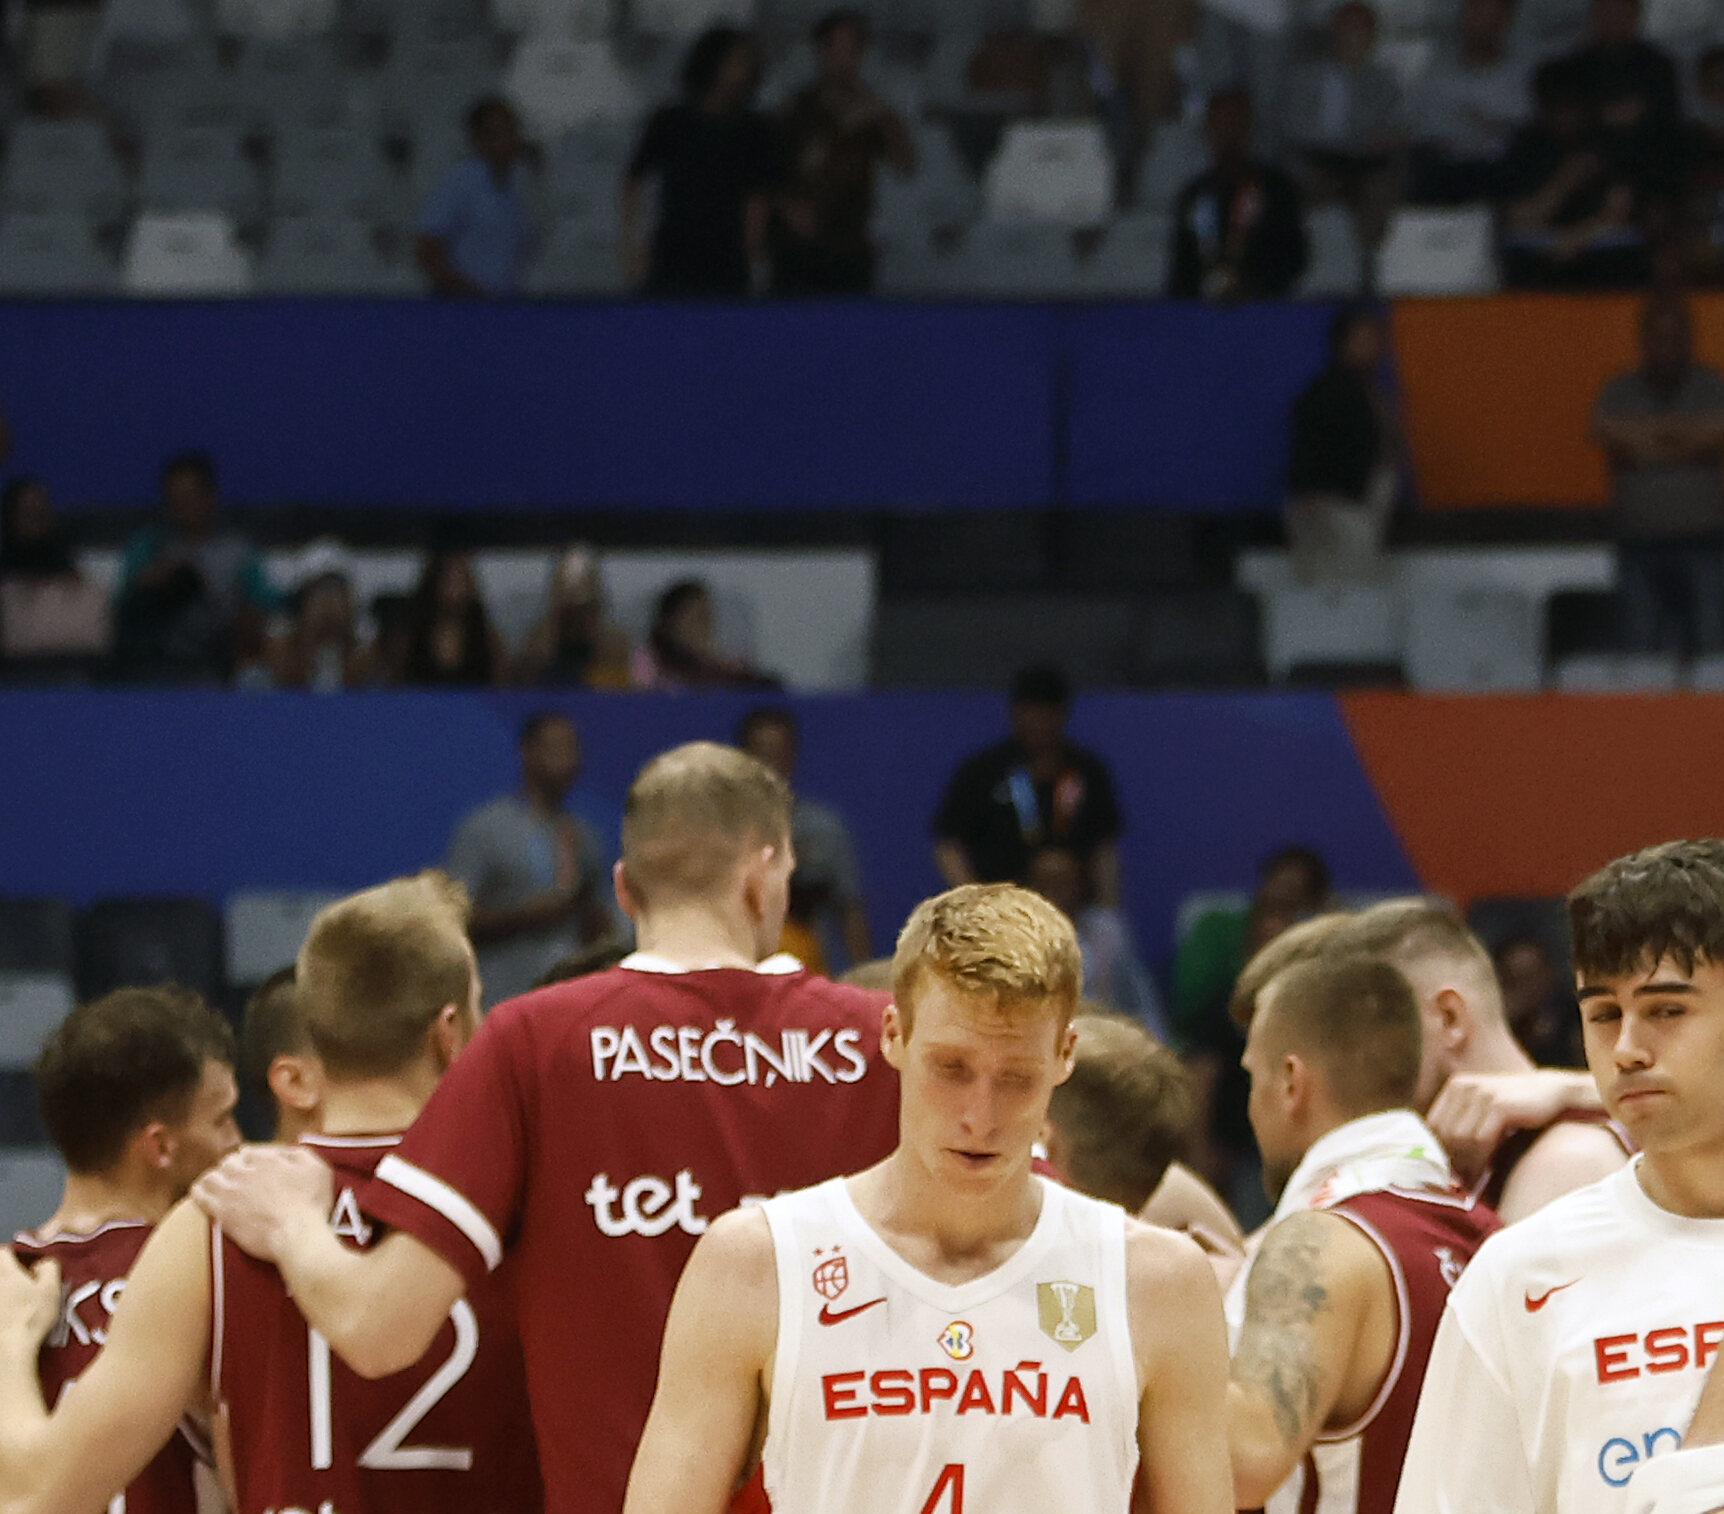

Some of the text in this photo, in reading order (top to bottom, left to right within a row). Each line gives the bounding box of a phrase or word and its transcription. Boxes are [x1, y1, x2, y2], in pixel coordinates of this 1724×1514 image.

[590, 1017, 868, 1087] PASEČŅIKS
[585, 1168, 709, 1237] tet
[821, 1360, 1090, 1425] ESPAÑA
